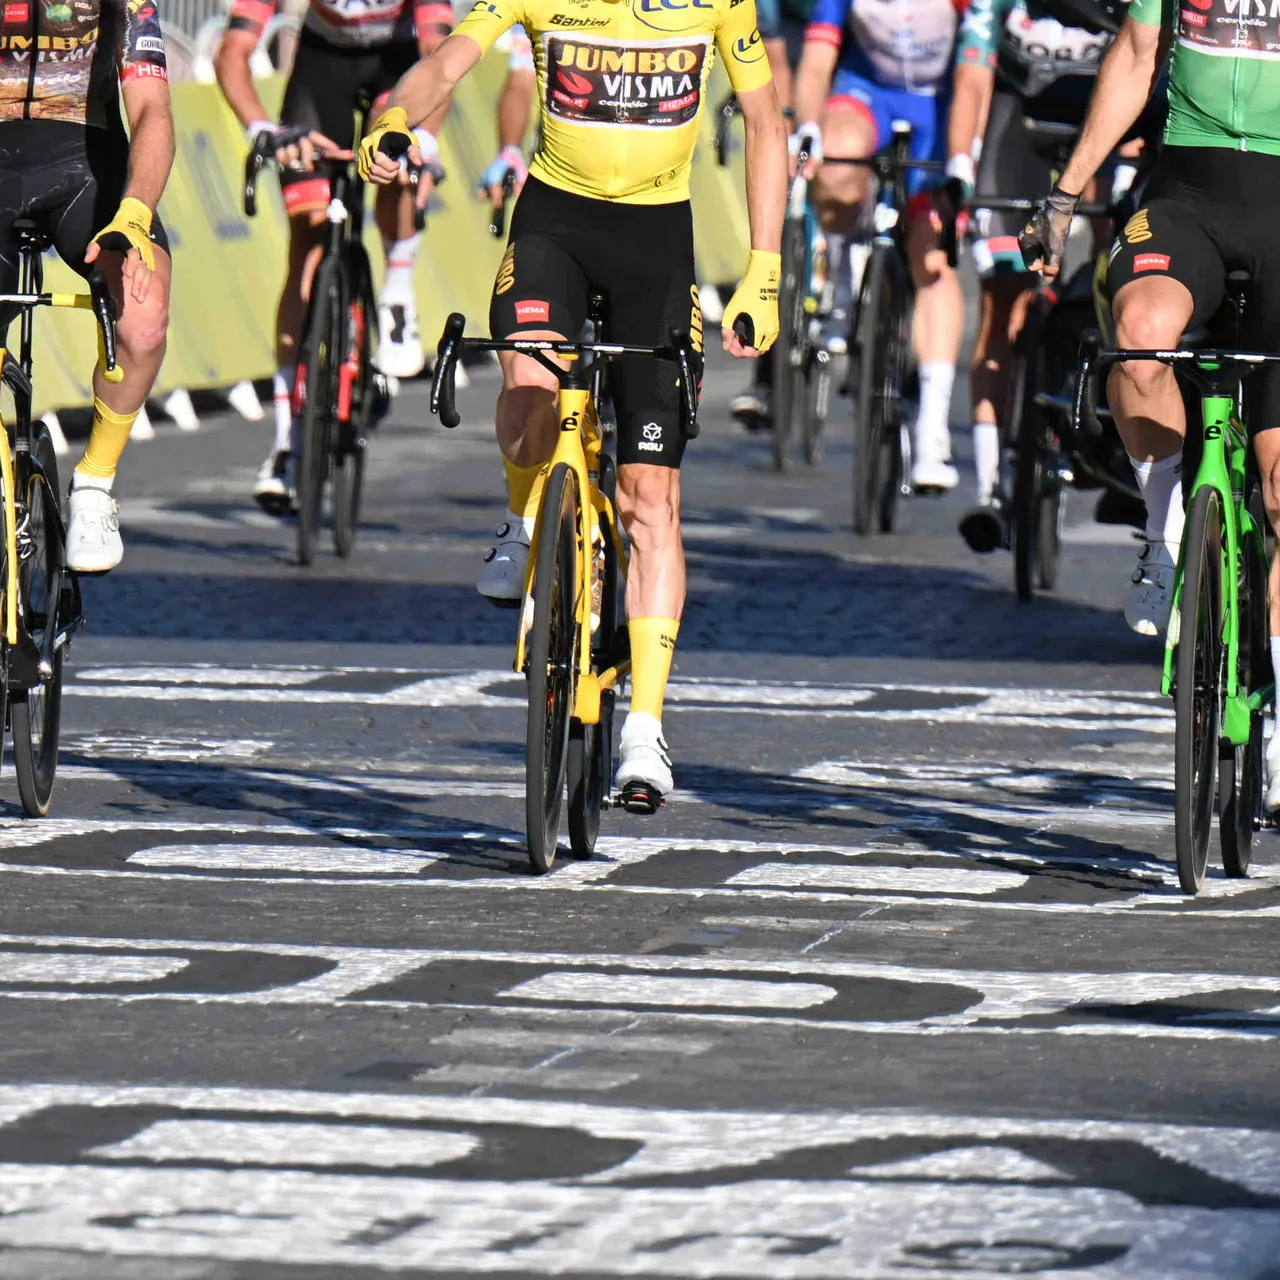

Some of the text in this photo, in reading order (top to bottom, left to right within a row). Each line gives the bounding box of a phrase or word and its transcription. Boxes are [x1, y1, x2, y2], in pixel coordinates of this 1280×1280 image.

[549, 13, 612, 28] Santini
[556, 43, 697, 74] JUMBO
[602, 73, 693, 99] VISMA
[663, 95, 695, 111] HEMA
[1135, 257, 1167, 267] HEMA
[517, 306, 546, 316] HEMA
[638, 441, 664, 452] AGU
